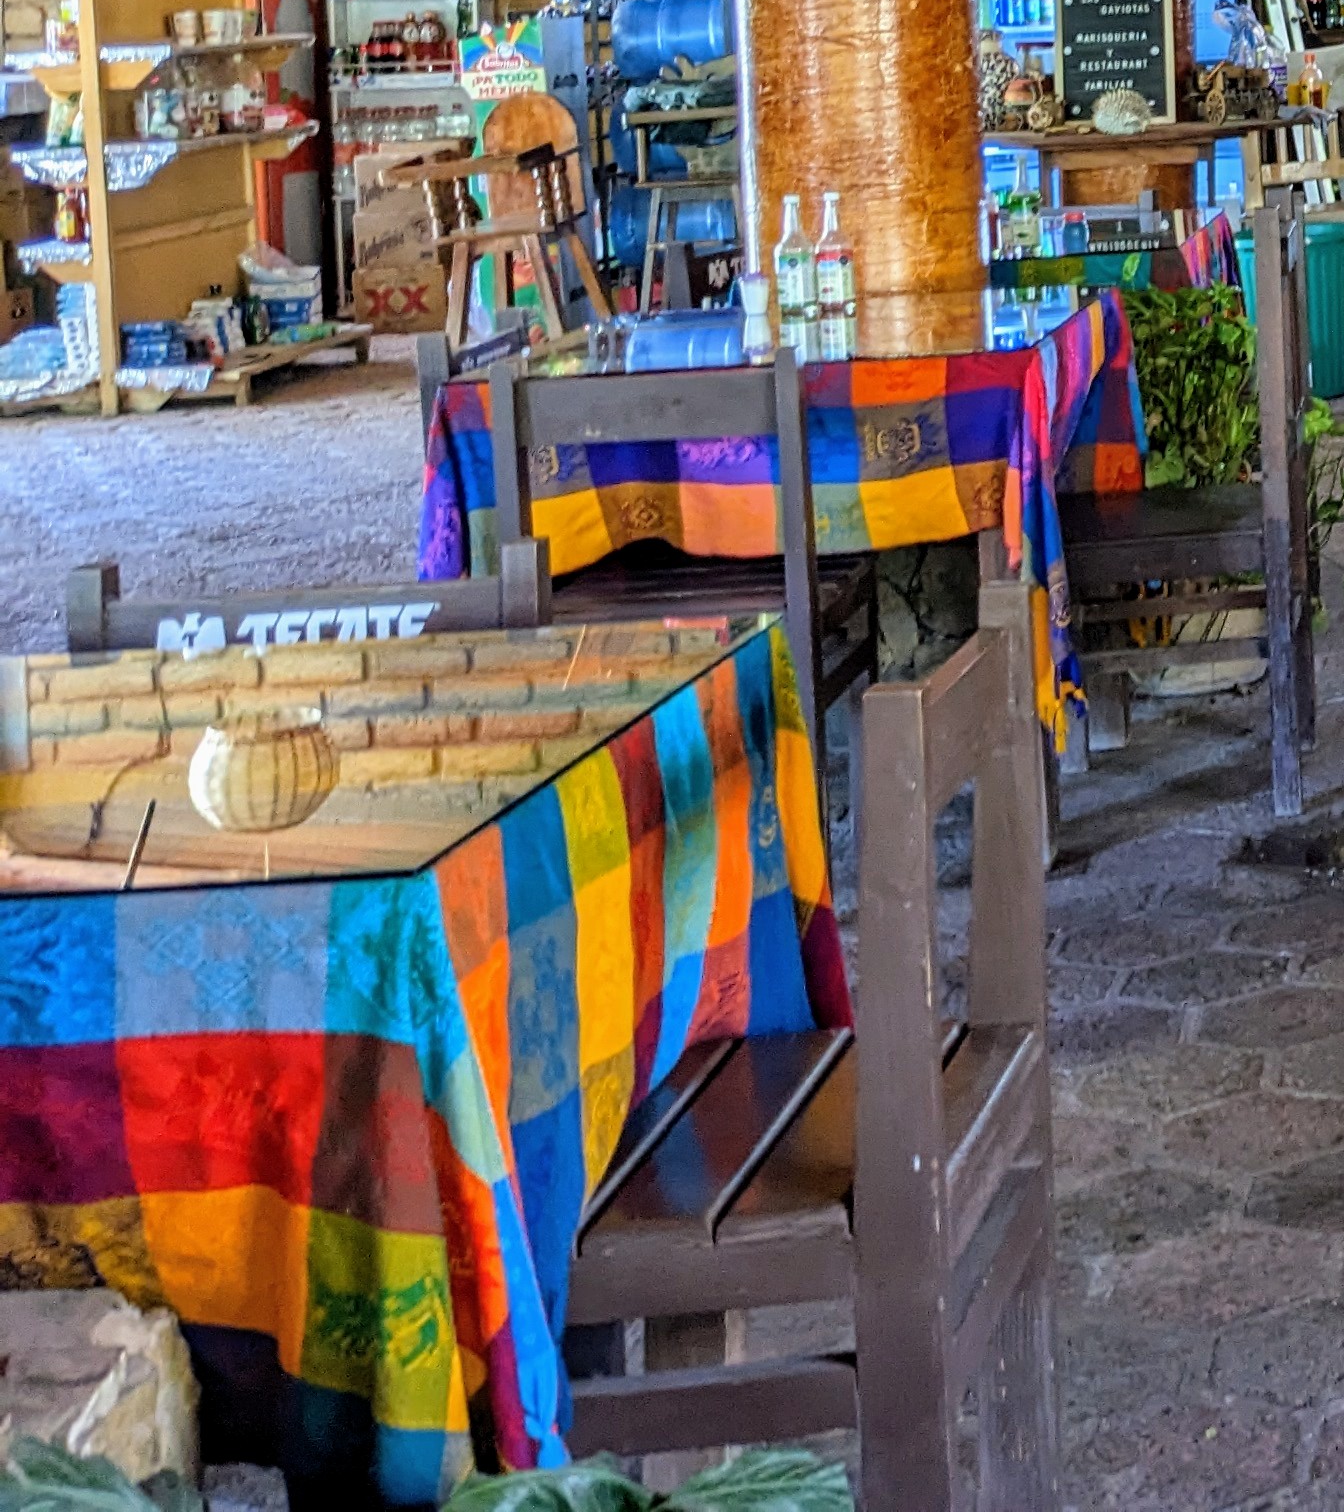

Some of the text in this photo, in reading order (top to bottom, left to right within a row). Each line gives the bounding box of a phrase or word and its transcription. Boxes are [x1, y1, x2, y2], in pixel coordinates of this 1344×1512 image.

[1101, 4, 1150, 15] GAVIOTAS
[1076, 31, 1148, 43] MARISQUERIA
[1080, 59, 1148, 72] RESTAURANT
[1084, 80, 1134, 91] FAMILIAR
[236, 602, 438, 648] TECATE
